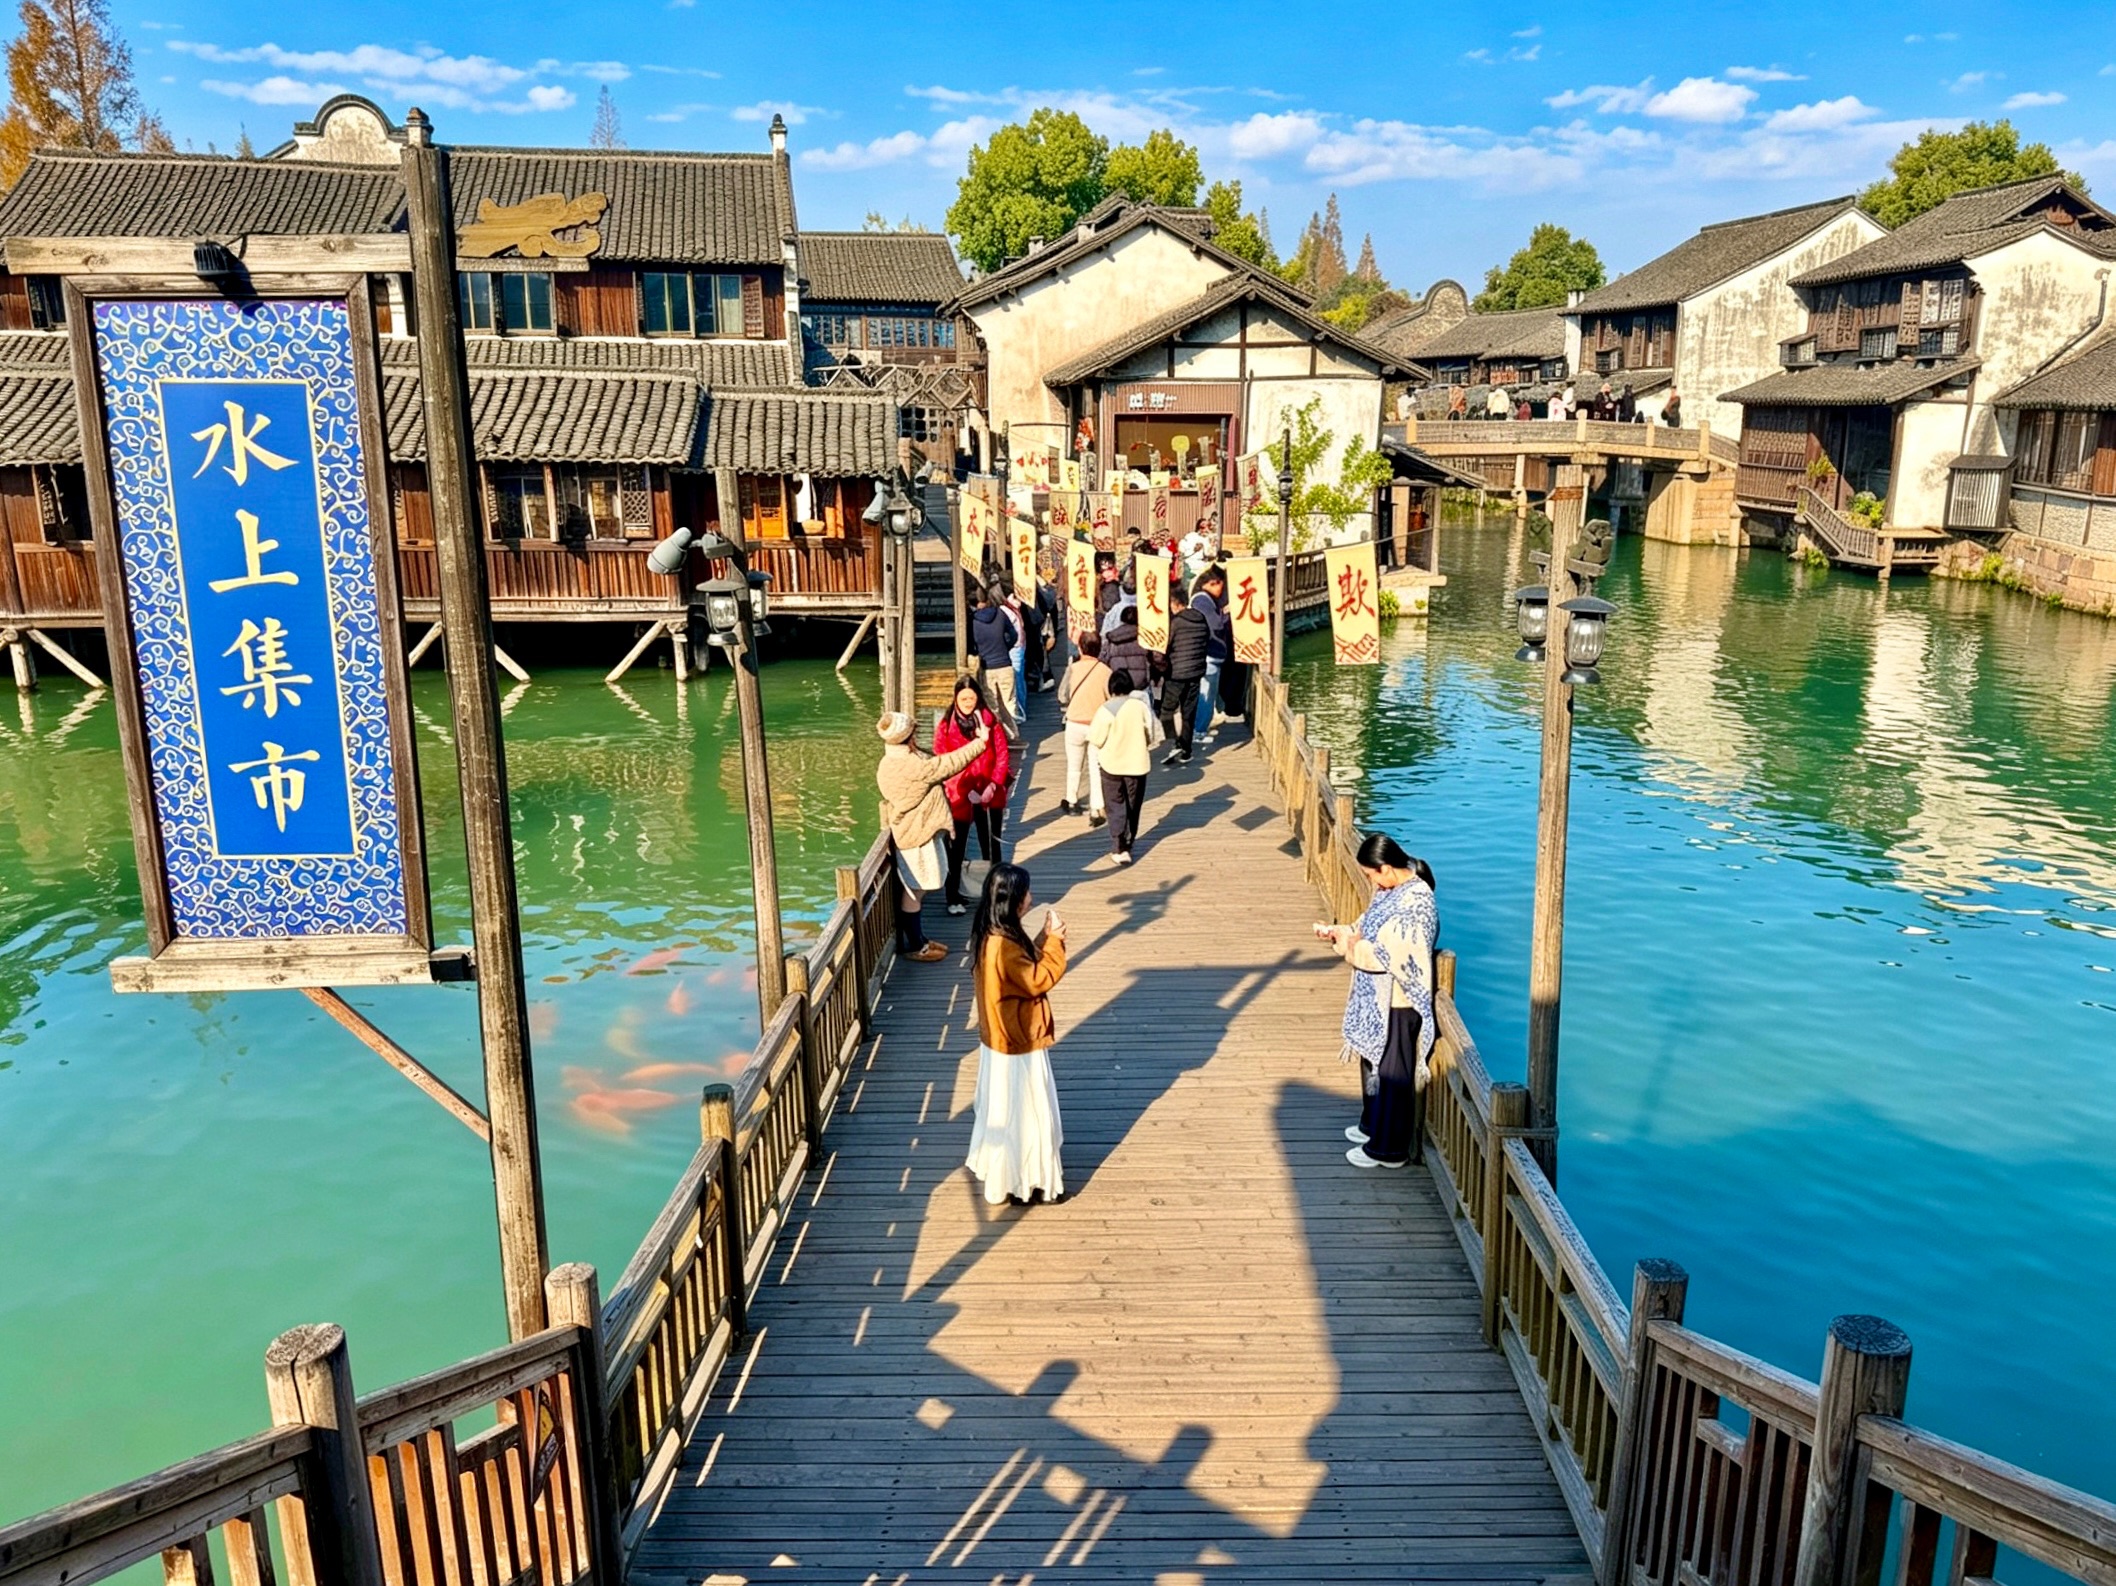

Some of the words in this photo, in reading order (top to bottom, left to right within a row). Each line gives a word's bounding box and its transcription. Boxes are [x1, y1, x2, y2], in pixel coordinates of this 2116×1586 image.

[191, 400, 321, 833] 水上集市
[1236, 575, 1266, 625] 无
[1335, 564, 1377, 621] 欺
